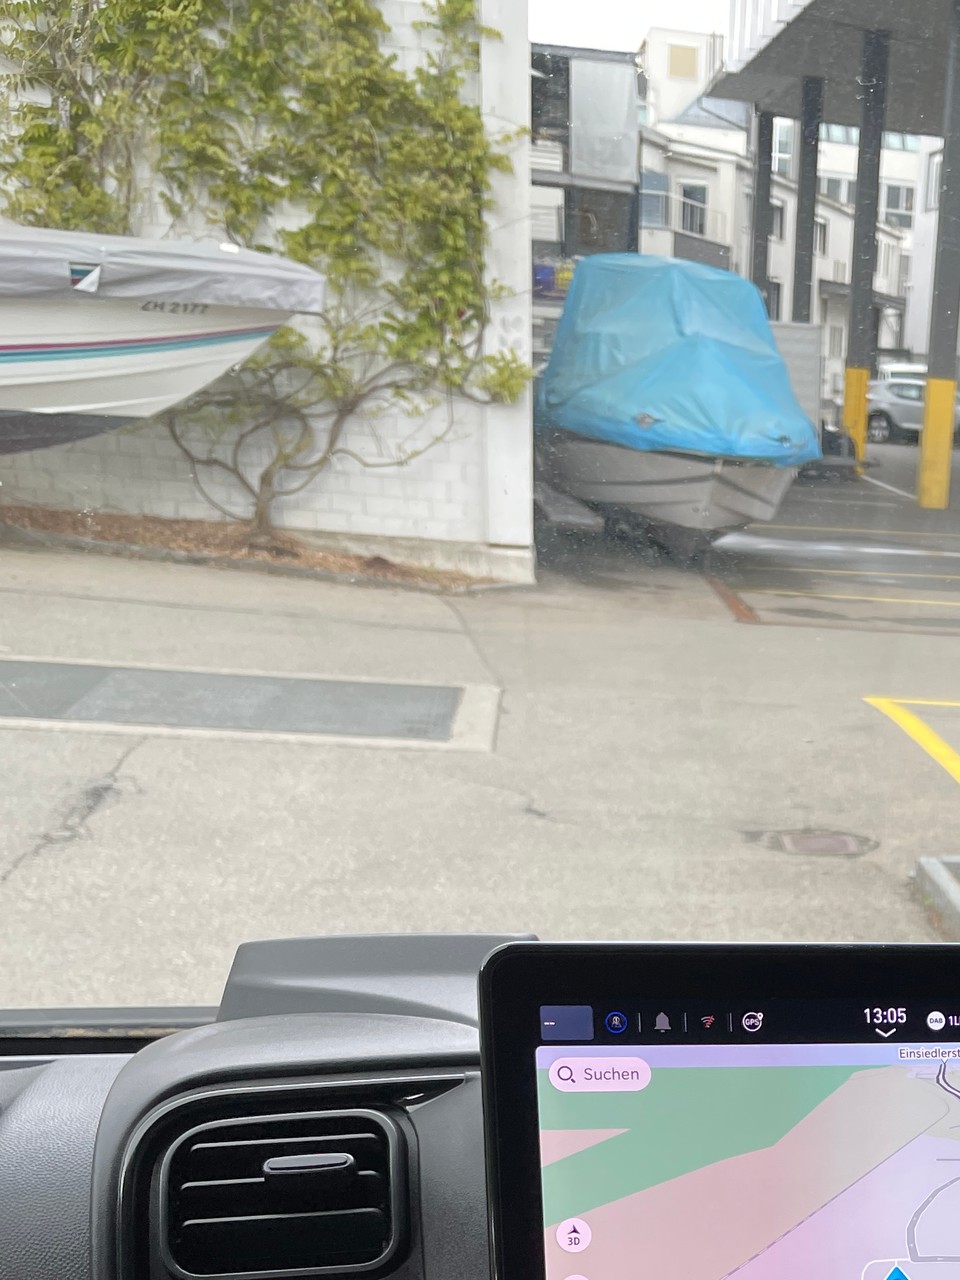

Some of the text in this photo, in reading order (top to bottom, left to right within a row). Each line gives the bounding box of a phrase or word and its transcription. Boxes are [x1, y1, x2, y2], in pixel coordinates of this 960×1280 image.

[745, 1015, 760, 1026] GPS
[864, 1008, 907, 1023] 13:05
[584, 1067, 640, 1081] Suchen
[567, 1236, 581, 1246] 3D
